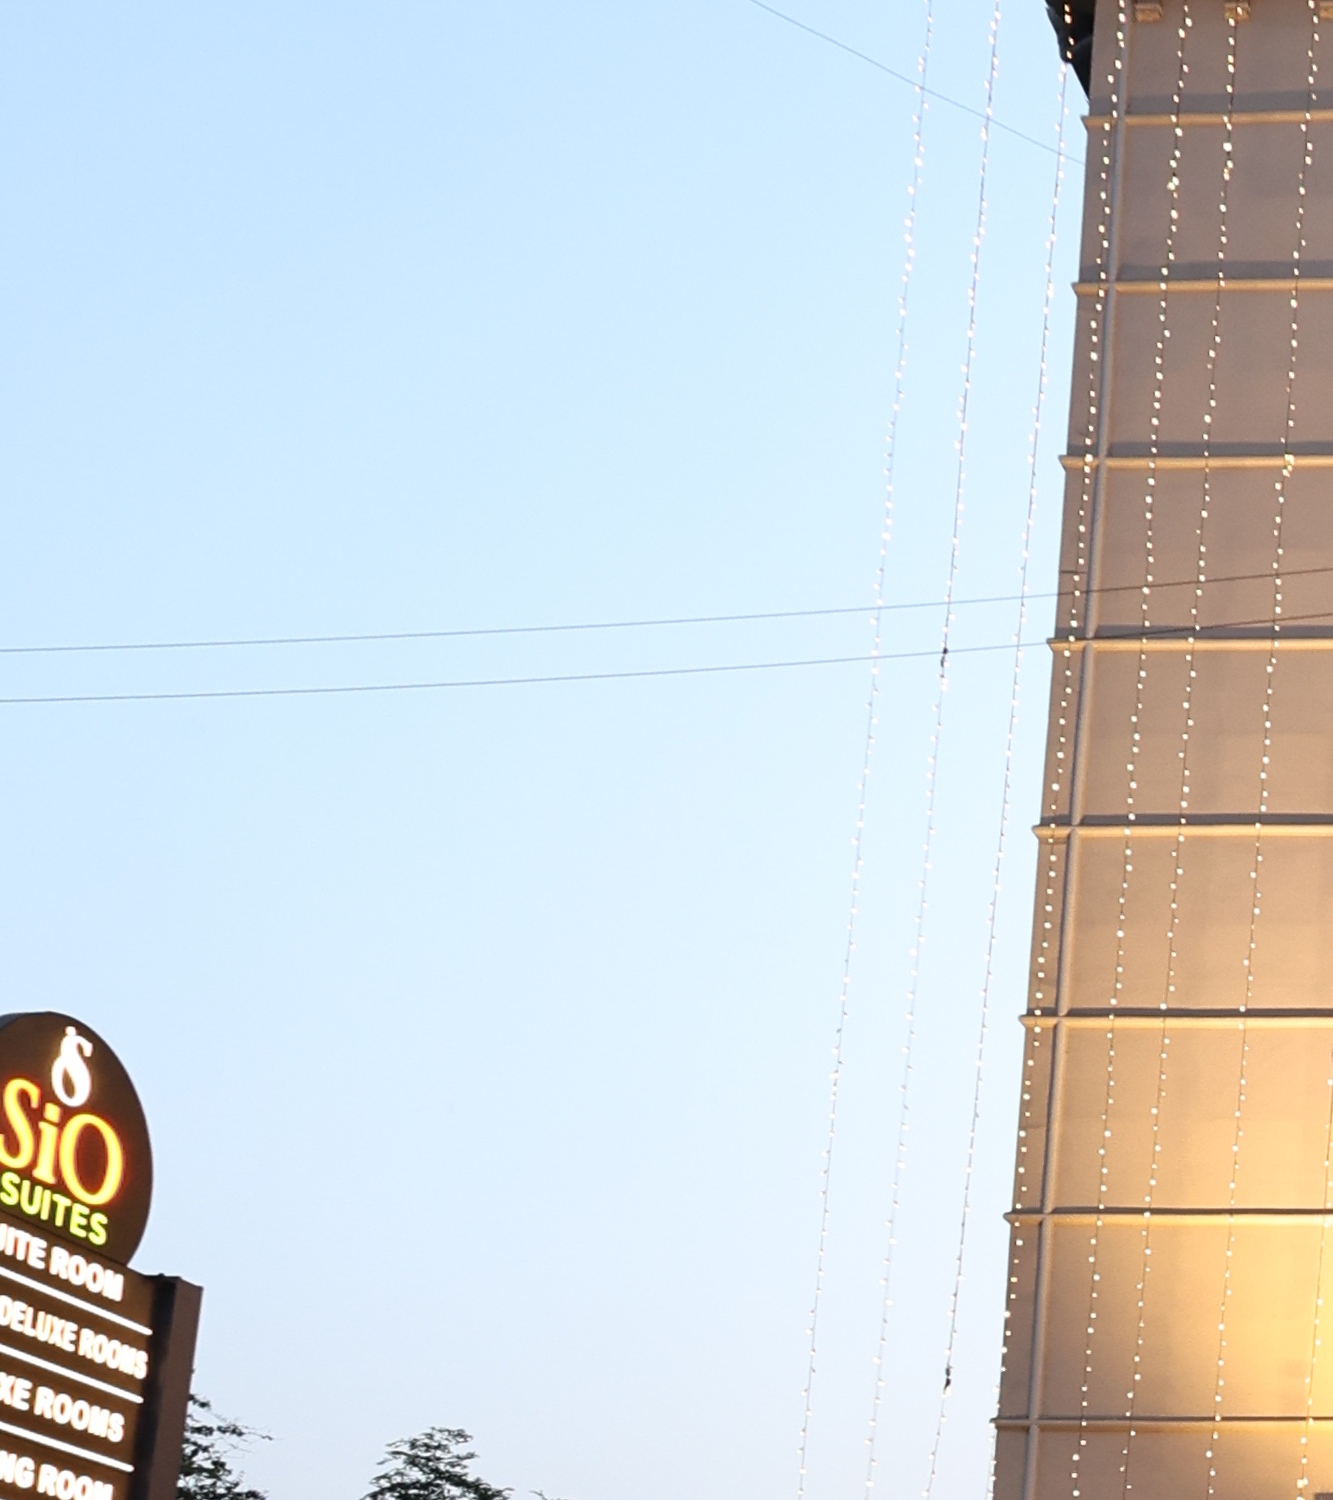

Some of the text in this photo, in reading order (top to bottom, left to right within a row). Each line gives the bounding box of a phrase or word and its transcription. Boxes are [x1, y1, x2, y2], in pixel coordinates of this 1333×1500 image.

[0, 1171, 108, 1246] SUITES
[49, 1246, 124, 1302] ROOM
[0, 1294, 149, 1380] DELUXE ROOMS
[34, 1386, 125, 1443] ROOMS
